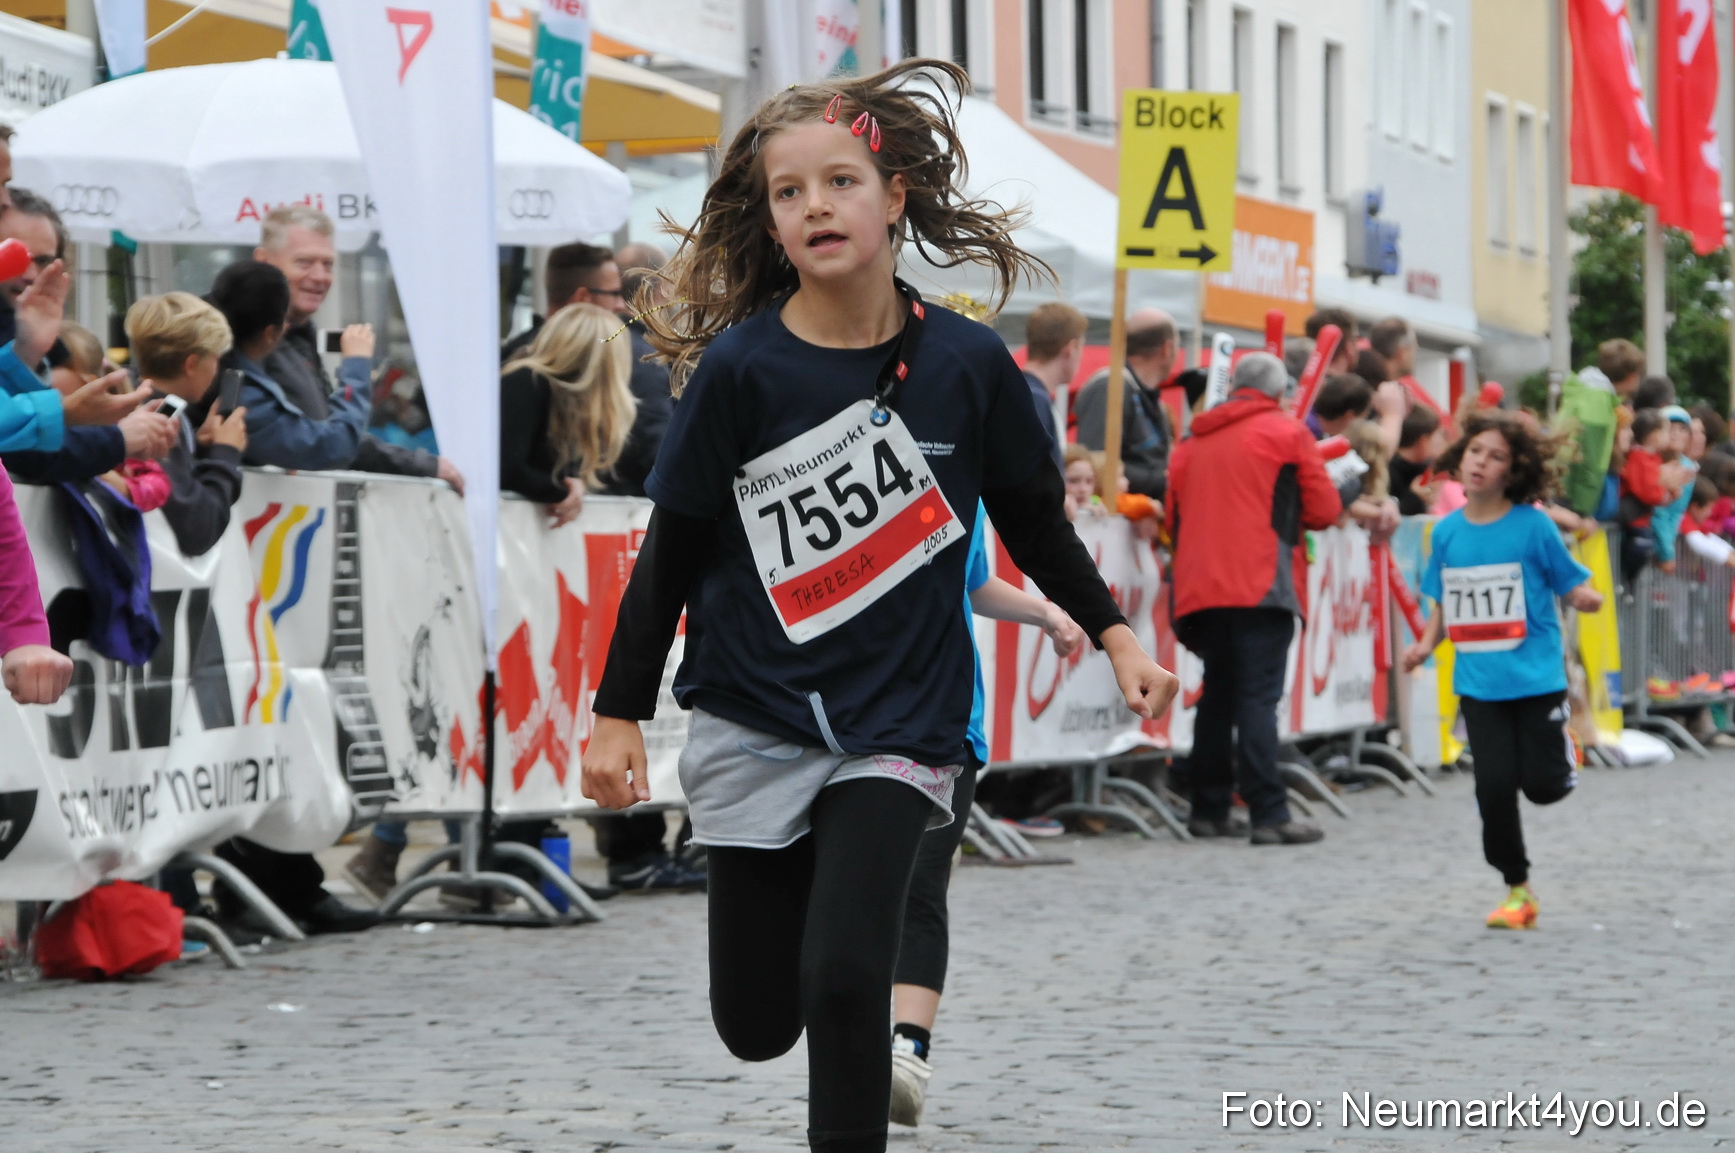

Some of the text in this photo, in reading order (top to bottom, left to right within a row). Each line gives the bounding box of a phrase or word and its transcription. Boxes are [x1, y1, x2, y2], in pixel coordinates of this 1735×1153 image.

[1136, 97, 1224, 129] Block
[1142, 146, 1206, 231] A
[738, 424, 867, 501] PARTL Neumarkt
[758, 438, 914, 568] 7554
[924, 525, 949, 555] 2005
[791, 553, 875, 611] THERESA
[1449, 586, 1515, 618] 7117
